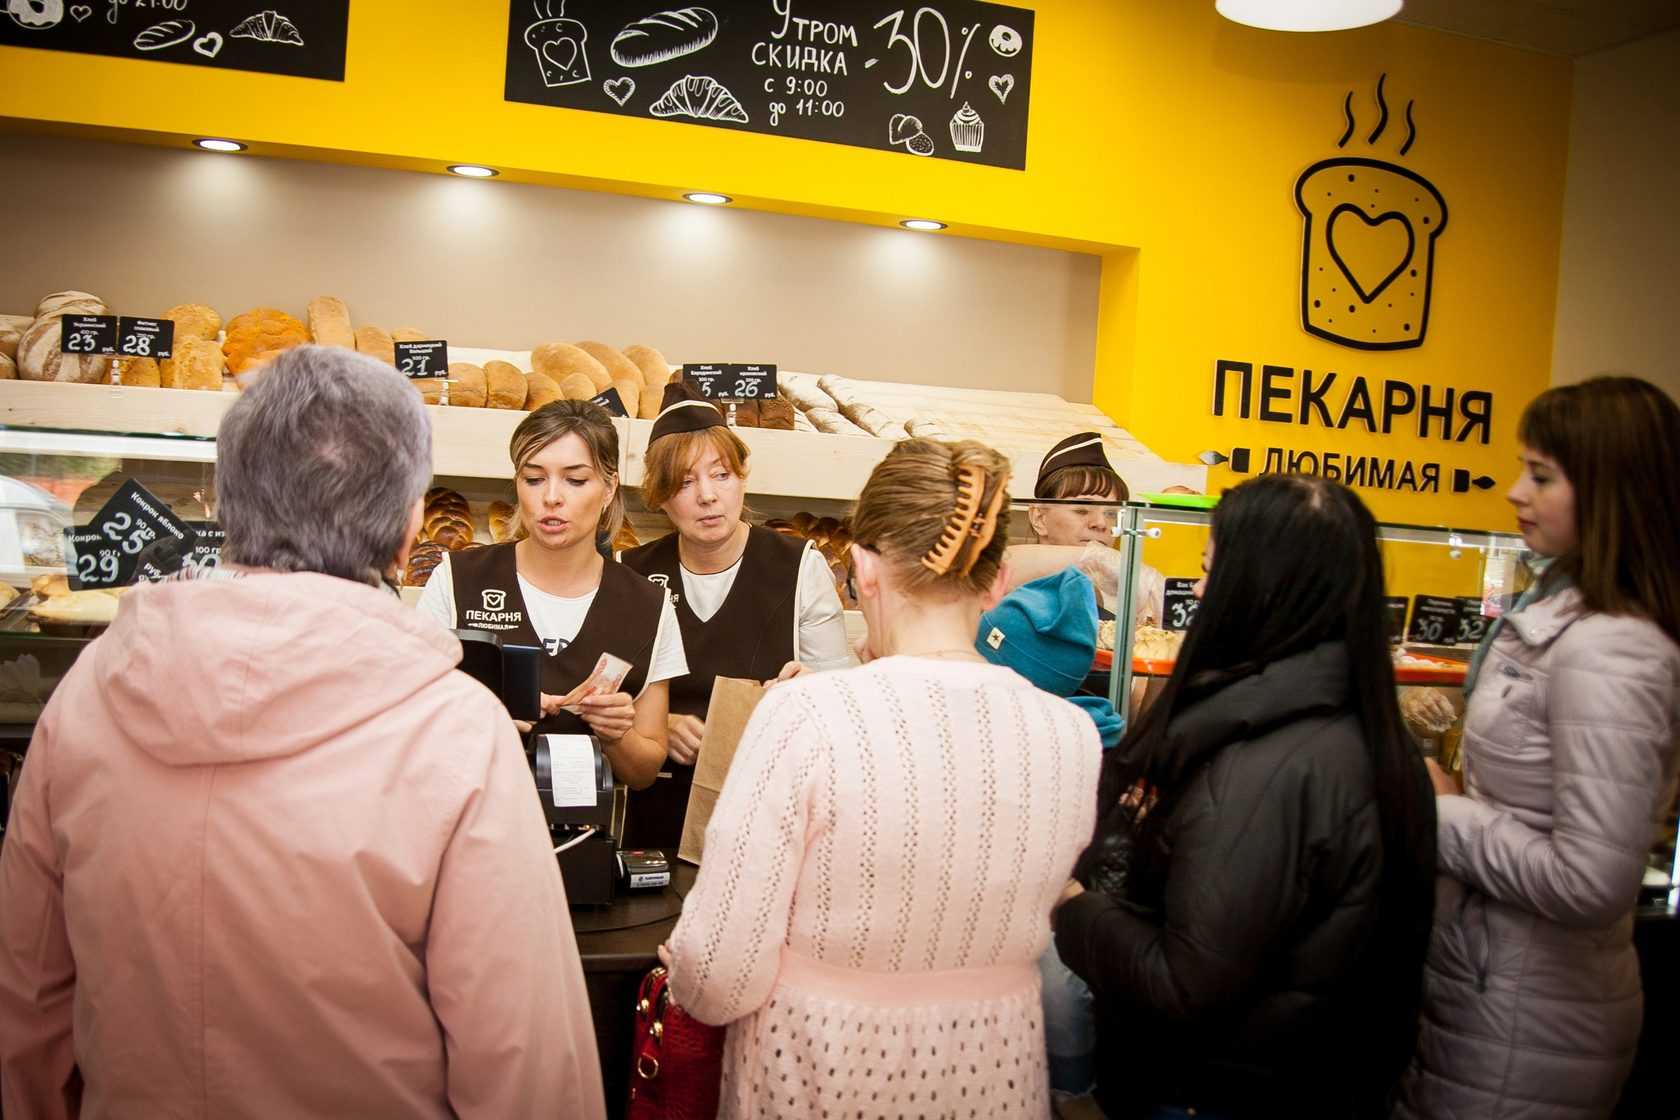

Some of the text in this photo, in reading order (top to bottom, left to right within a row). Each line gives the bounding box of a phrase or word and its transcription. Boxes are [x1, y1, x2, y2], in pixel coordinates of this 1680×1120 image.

[752, 42, 848, 76] СКИДКА
[786, 76, 828, 97] 9:00
[769, 99, 845, 126] до 11:00
[68, 333, 96, 351] 23
[122, 335, 150, 356] 28
[401, 358, 429, 377] 21
[701, 381, 712, 397] 5
[734, 380, 759, 397] 26
[1211, 359, 1493, 445] ПЕКАРНЯ
[1258, 447, 1440, 493] ЛЮБИМАЯ
[103, 512, 152, 554] 25
[195, 546, 210, 554] 100
[79, 554, 119, 582] 29
[466, 610, 522, 622] ПЕКАРНЯ
